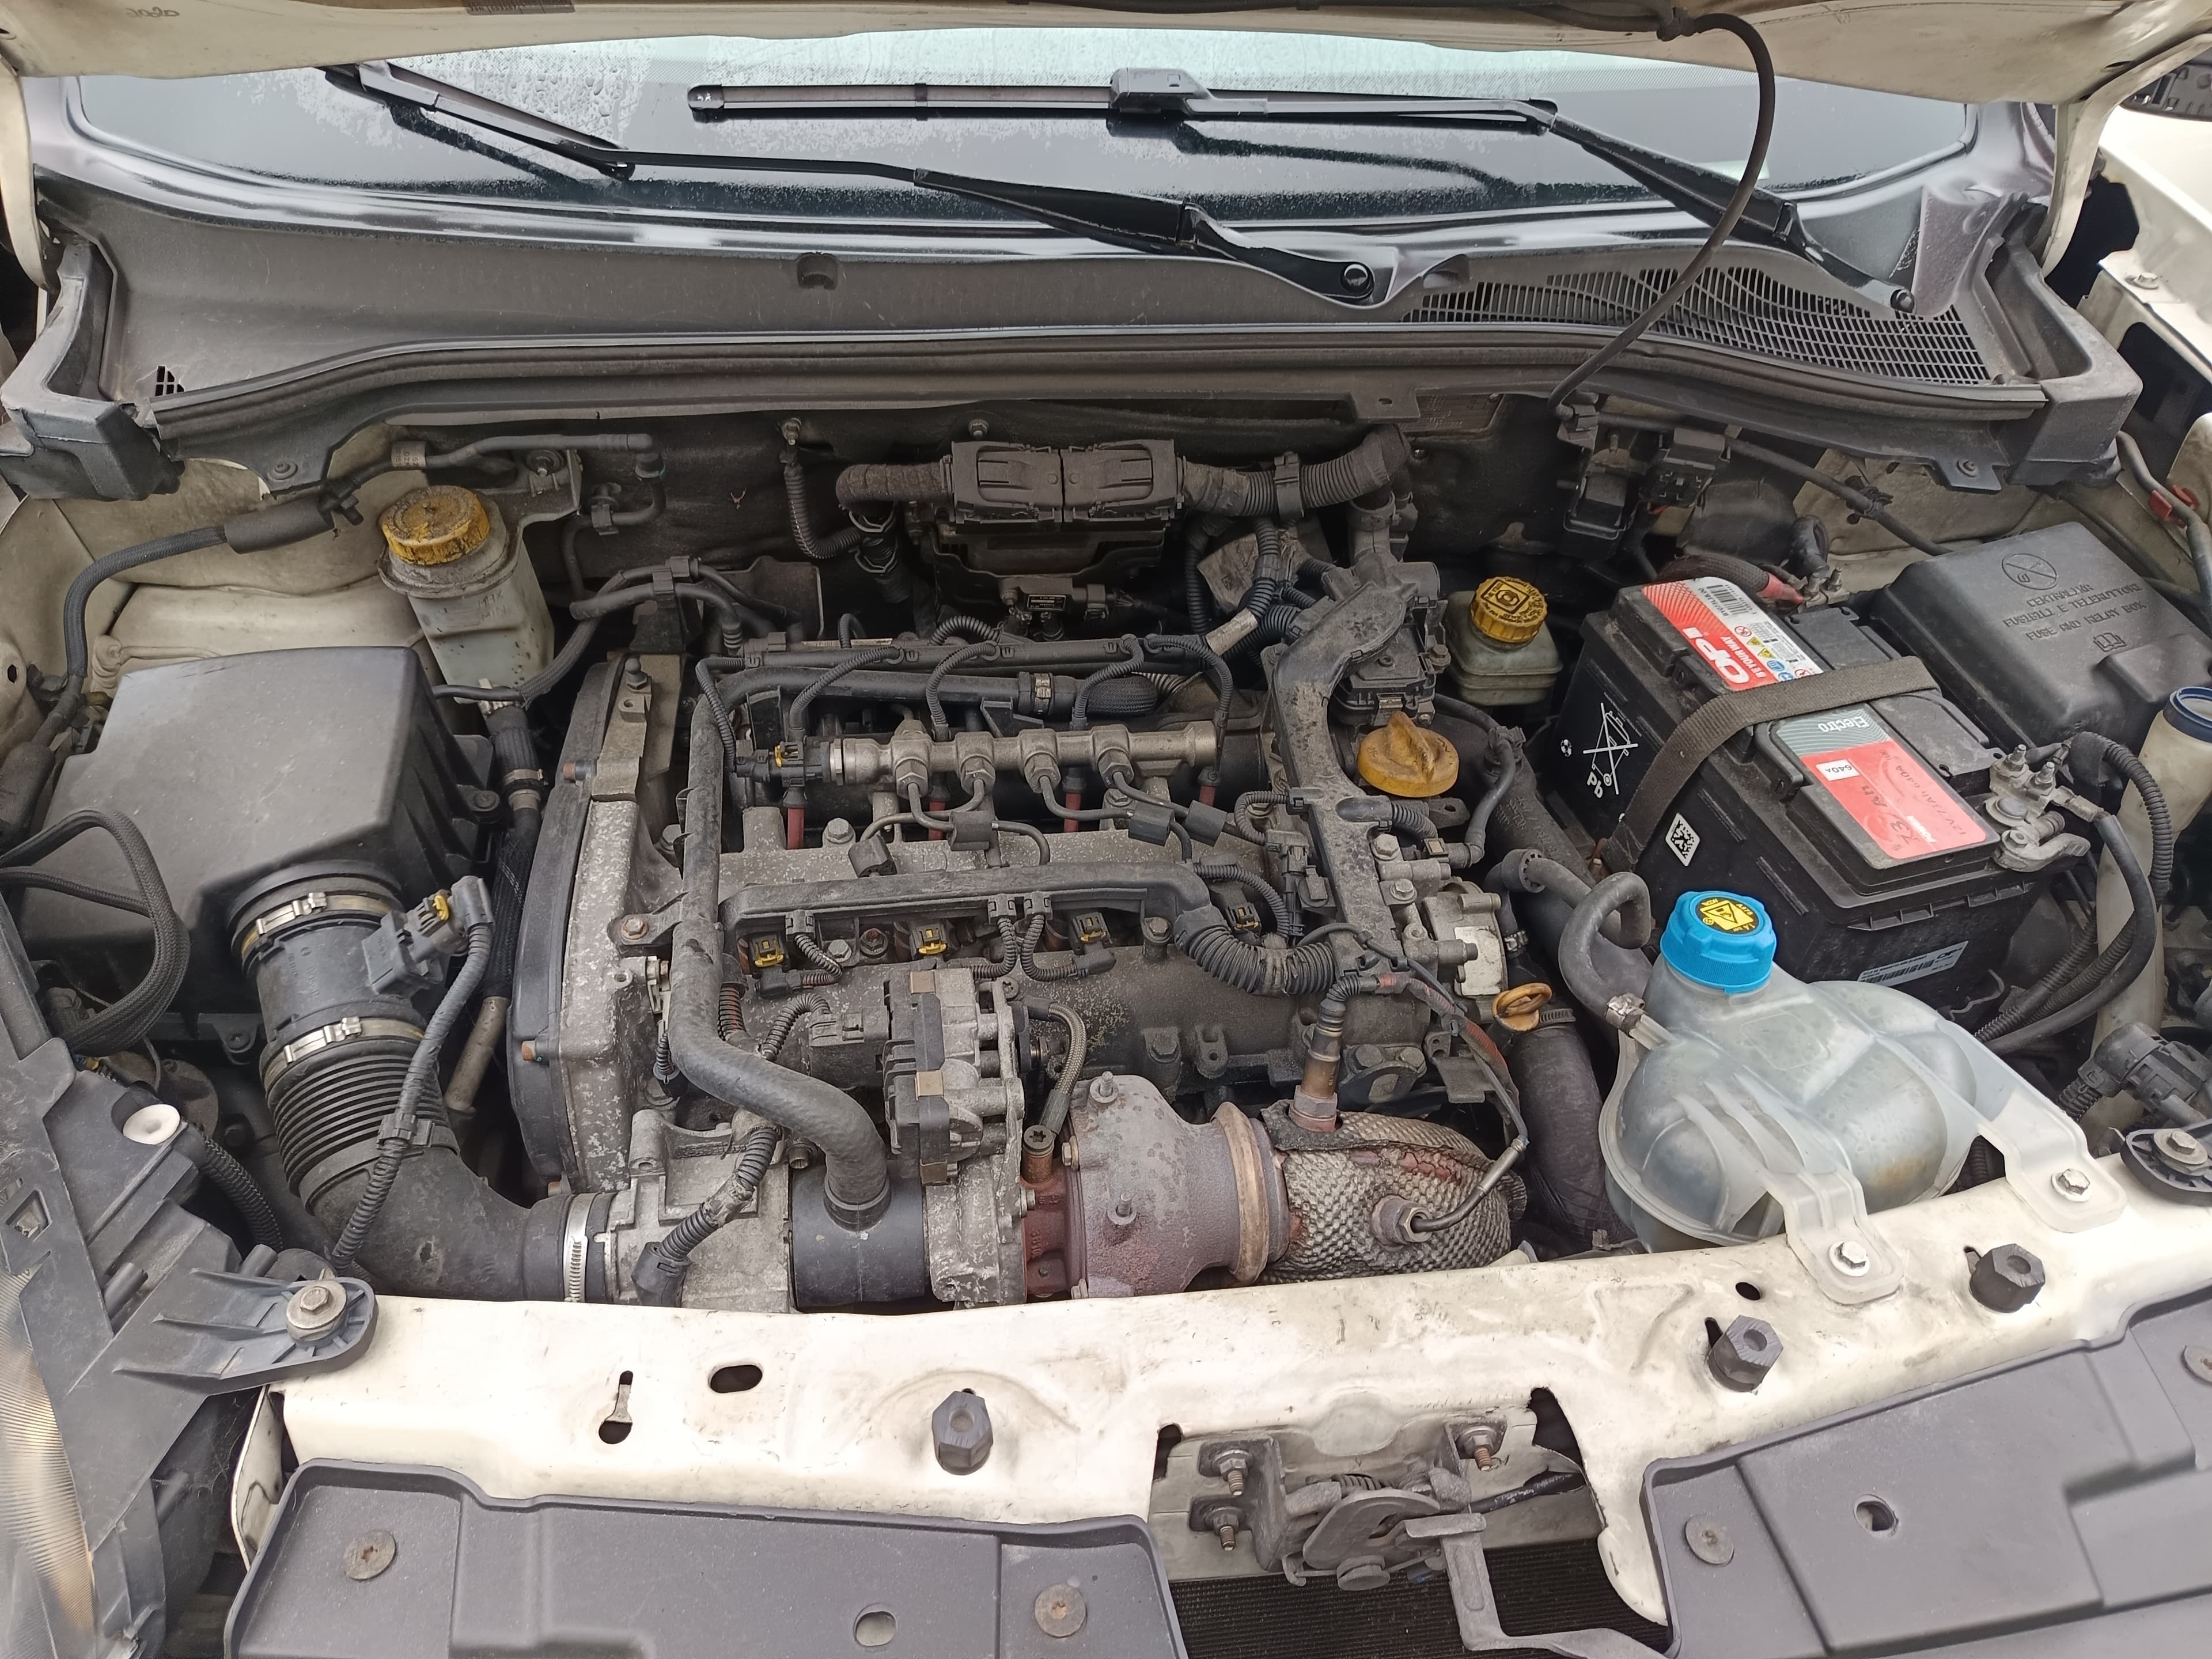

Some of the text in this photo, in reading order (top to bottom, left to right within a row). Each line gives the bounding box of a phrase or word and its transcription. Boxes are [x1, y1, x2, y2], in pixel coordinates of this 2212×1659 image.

[2002, 583, 2143, 627] FUSIBILI E TELERUTTORI
[2027, 584, 2094, 607] CENTRALINA
[2025, 600, 2147, 641] FUSE AND RELAY BOX
[1720, 635, 1739, 654] WAY
[1734, 650, 1759, 669] YOUR
[1817, 716, 1870, 733] Electro
[1825, 764, 1853, 774] 640A
[1586, 771, 1603, 798] Pb
[1945, 818, 1967, 836] 12V
